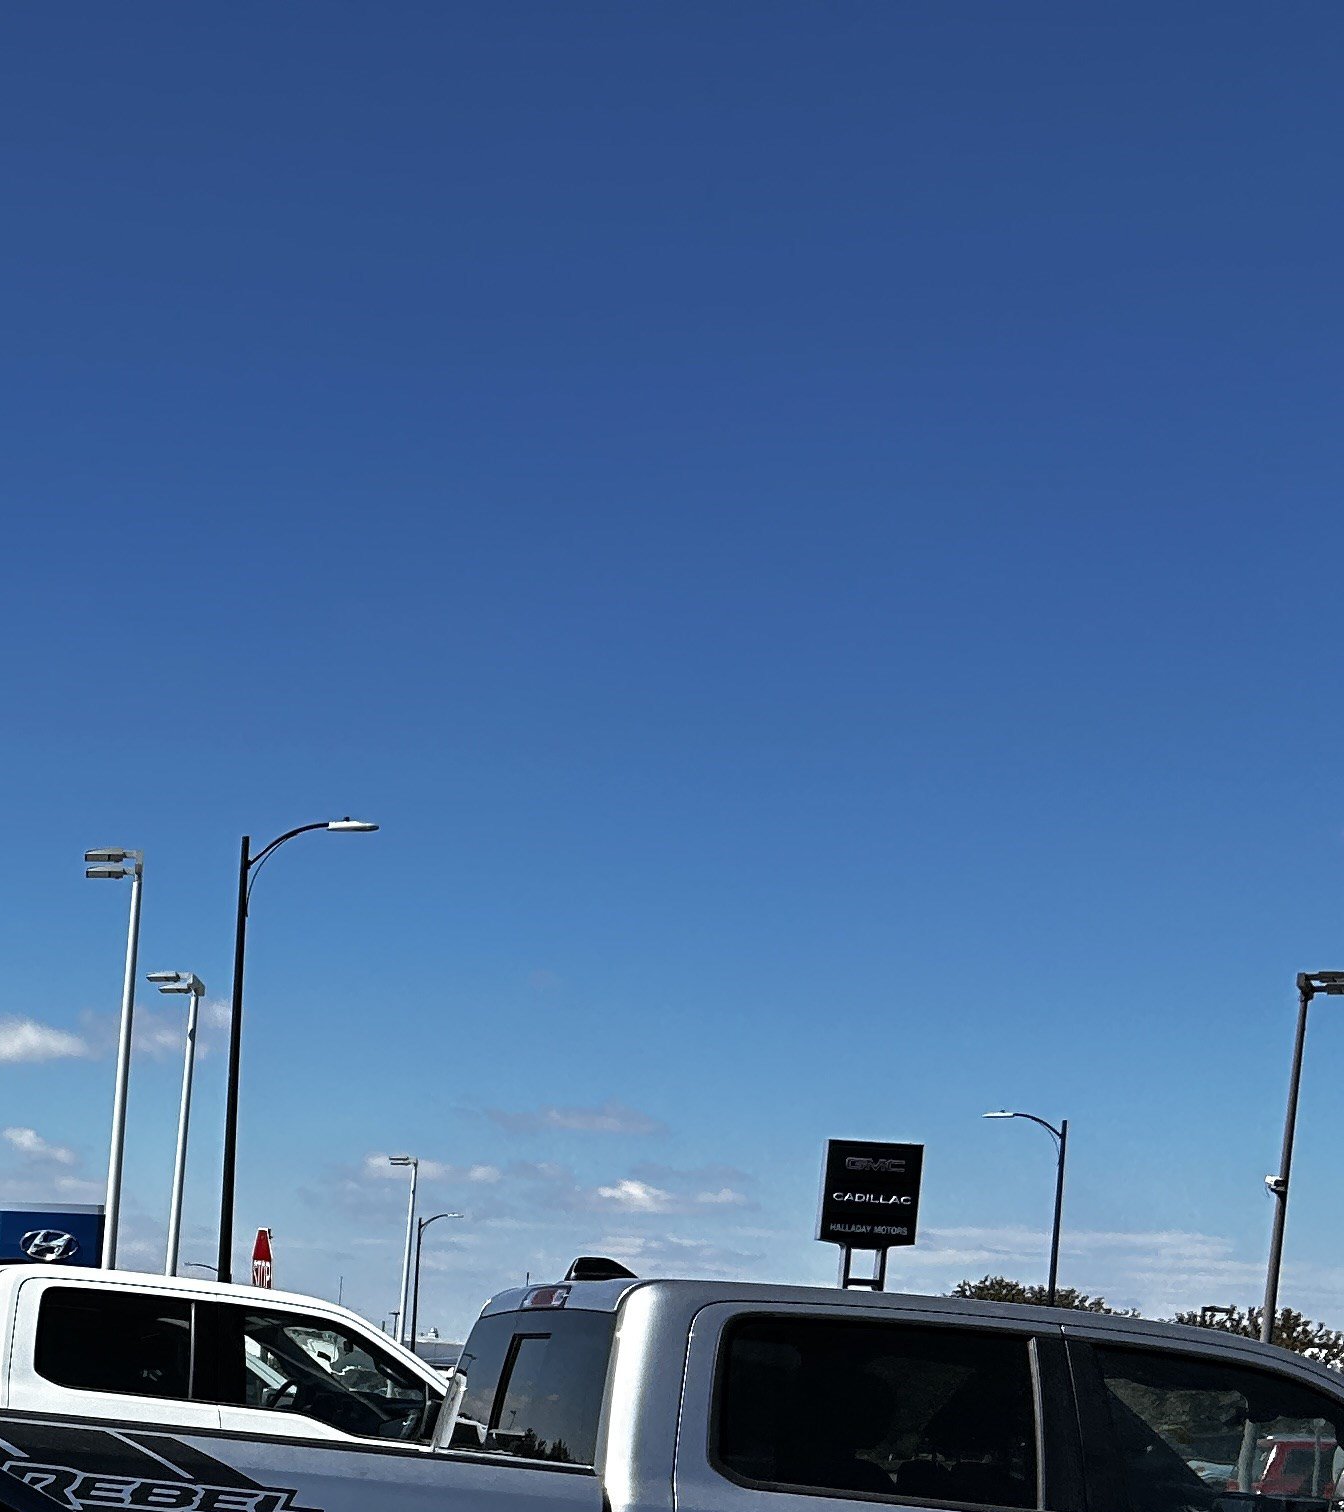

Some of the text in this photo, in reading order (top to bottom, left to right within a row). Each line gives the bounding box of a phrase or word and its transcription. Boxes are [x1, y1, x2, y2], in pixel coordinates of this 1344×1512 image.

[845, 1157, 906, 1173] GMC
[832, 1192, 912, 1205] CADILLAC
[829, 1222, 908, 1236] HALLADAY MOTORS
[253, 1260, 271, 1289] STOP
